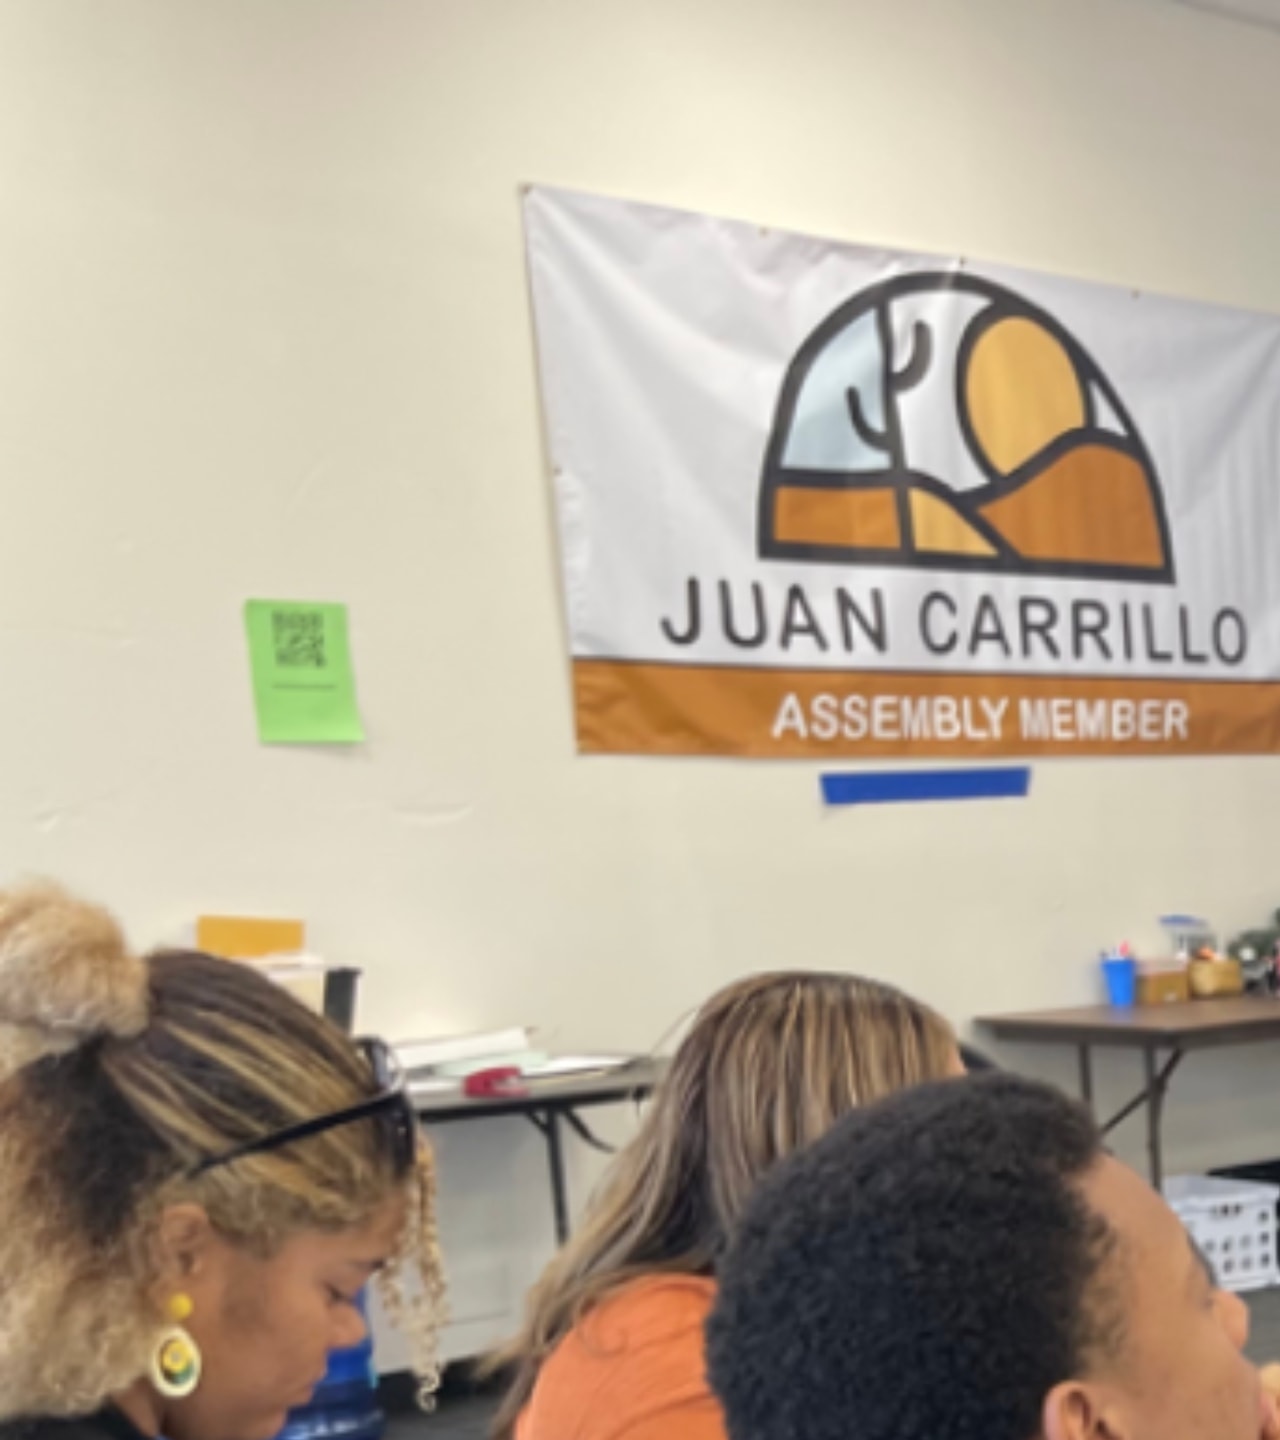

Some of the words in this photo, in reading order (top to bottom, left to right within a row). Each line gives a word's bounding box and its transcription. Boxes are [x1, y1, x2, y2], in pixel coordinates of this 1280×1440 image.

[660, 576, 888, 654] JUAN
[918, 592, 1248, 667] CARRILLO
[771, 692, 1009, 740] ASSEMBLY
[1019, 697, 1190, 741] MEMBER
